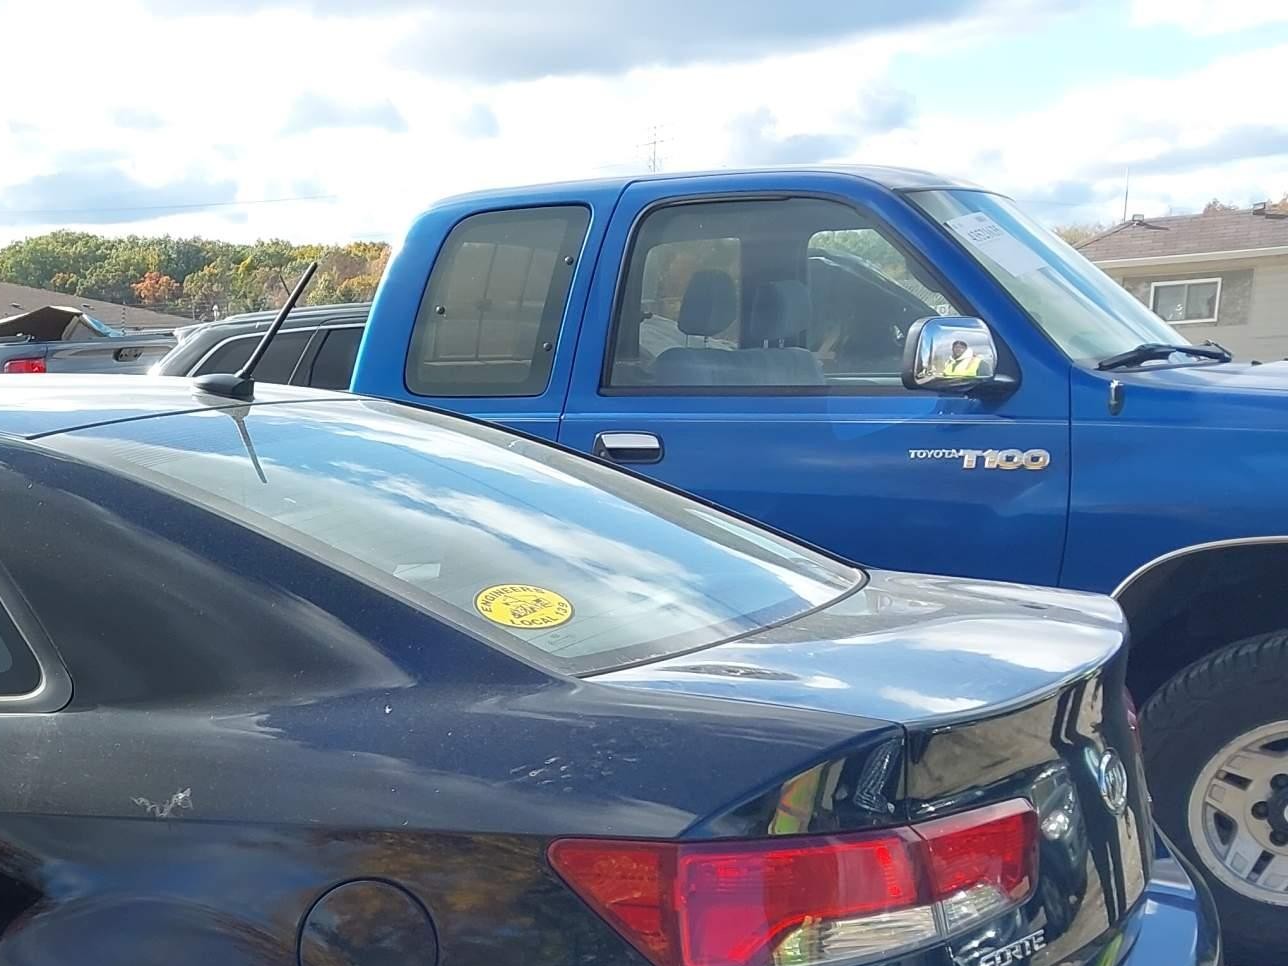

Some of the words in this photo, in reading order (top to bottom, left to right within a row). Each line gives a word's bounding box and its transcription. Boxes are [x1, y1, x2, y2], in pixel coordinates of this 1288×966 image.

[908, 449, 959, 459] TOYOTA
[959, 448, 1050, 470] T100
[510, 615, 559, 626] LOCAL
[555, 601, 568, 617] 139
